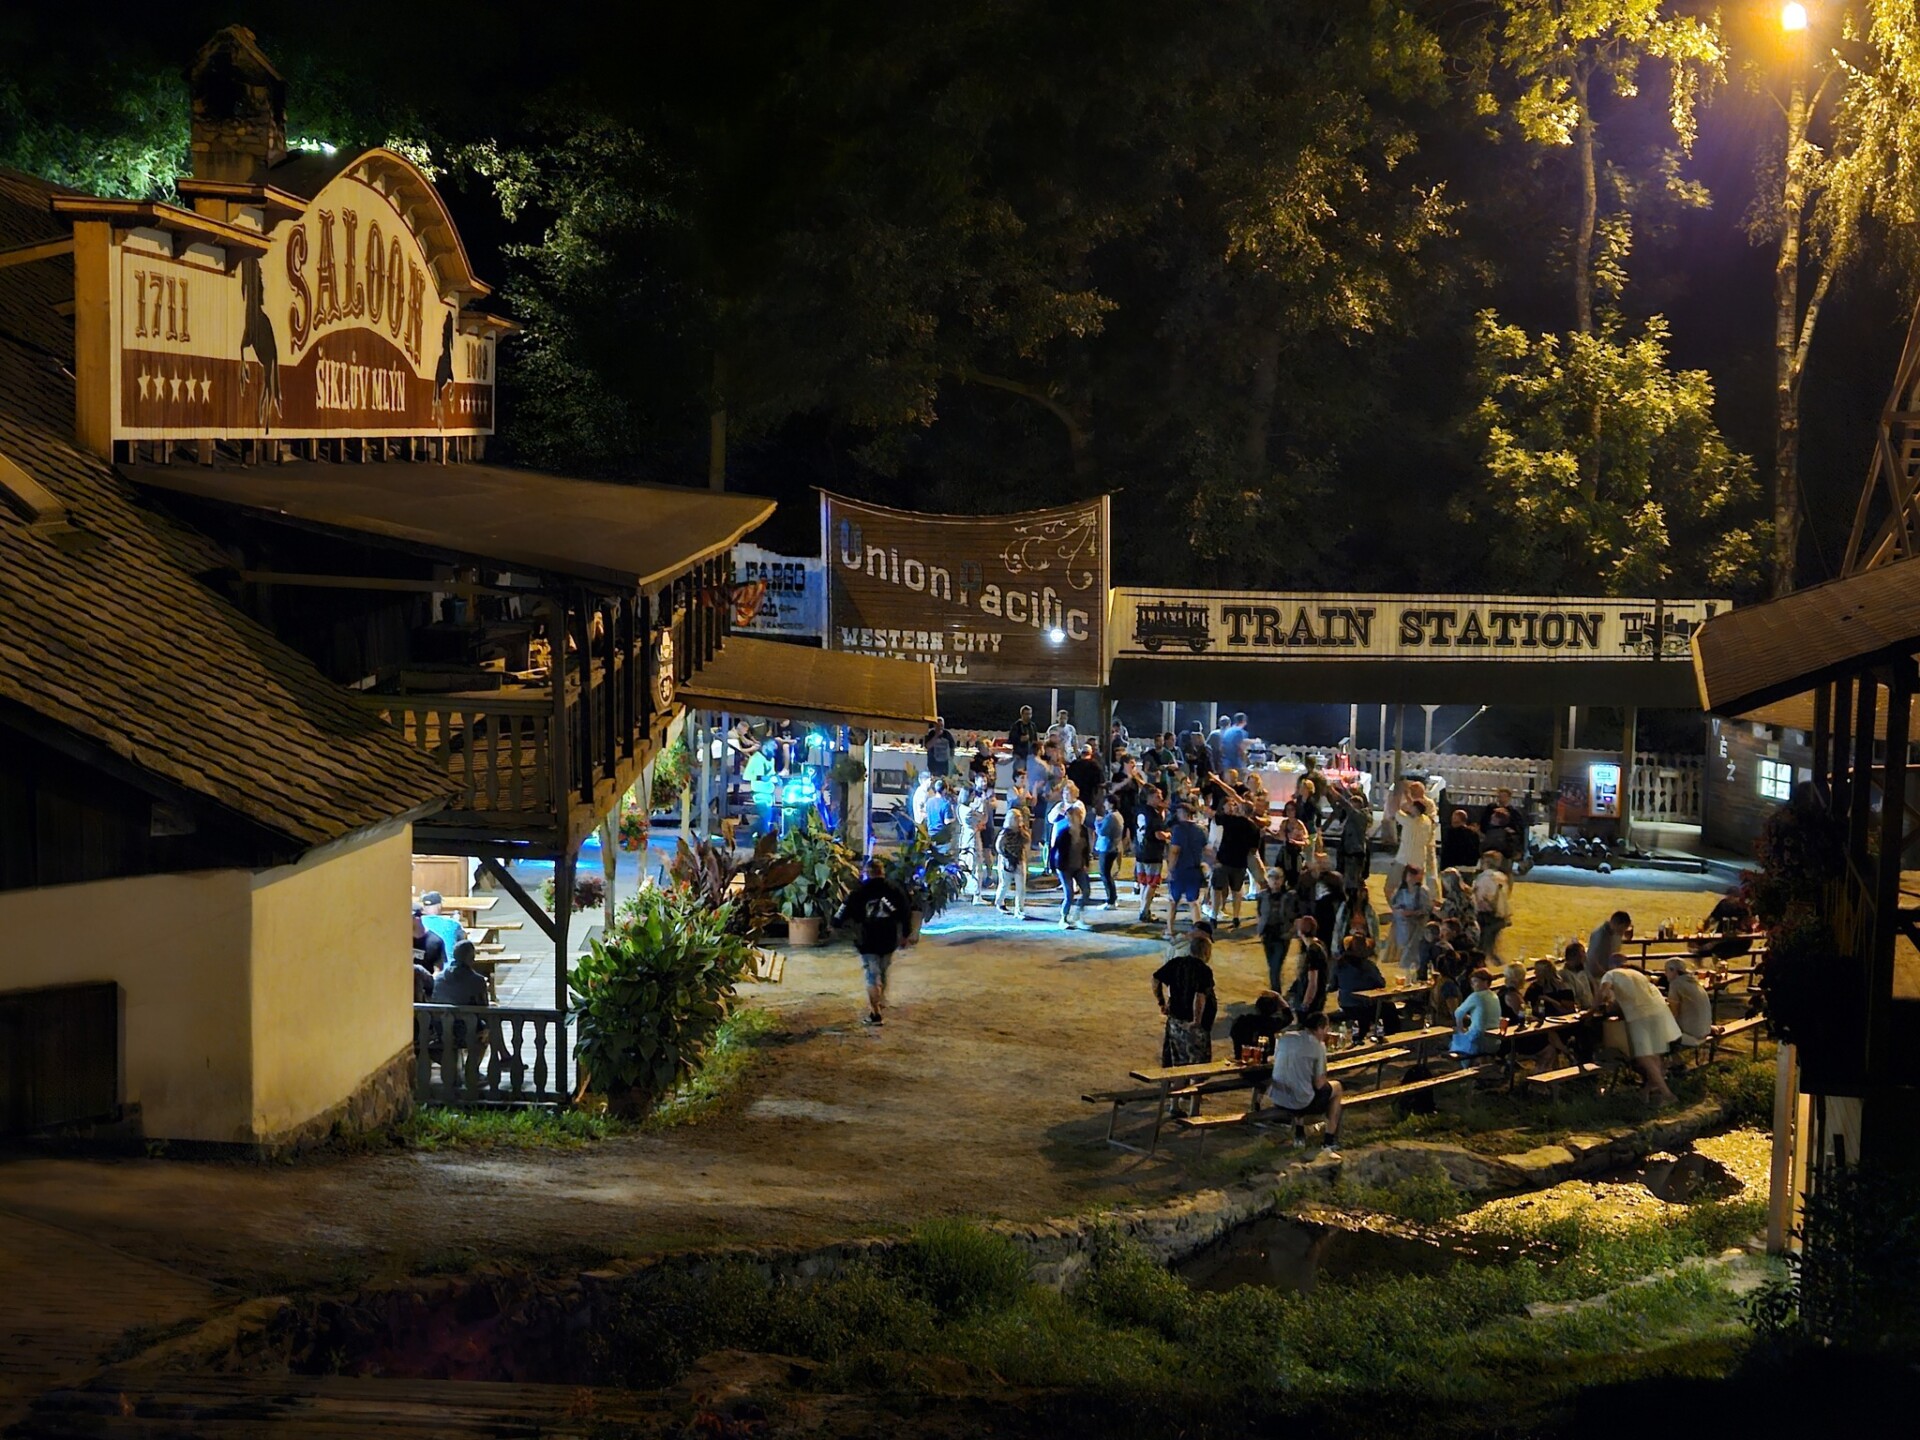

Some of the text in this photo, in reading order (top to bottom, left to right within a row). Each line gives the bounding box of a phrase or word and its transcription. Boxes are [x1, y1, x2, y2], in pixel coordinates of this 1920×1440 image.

[134, 269, 191, 343] 1711
[286, 207, 426, 366] SALOON
[315, 346, 406, 413] ŠIKLŮV MLÝN
[841, 518, 1089, 641] Union Pacific
[840, 626, 1002, 653] WESTERN CITY
[1221, 604, 1606, 650] TRAIN STATION
